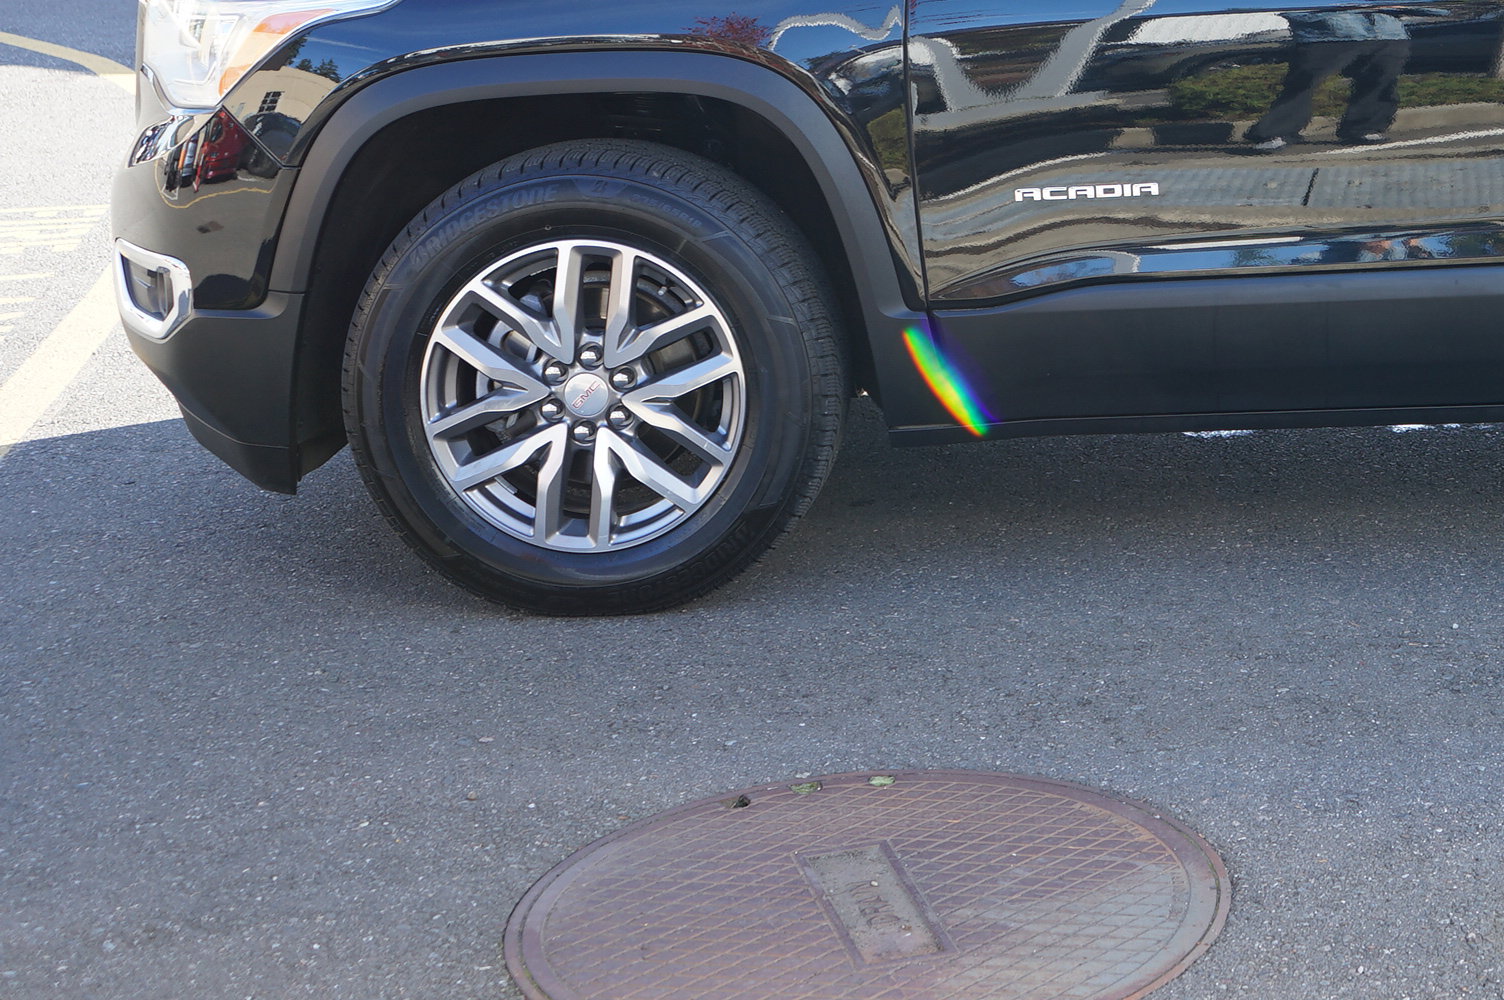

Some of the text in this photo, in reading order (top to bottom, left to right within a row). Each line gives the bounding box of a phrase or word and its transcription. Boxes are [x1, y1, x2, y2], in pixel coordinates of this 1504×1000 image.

[1014, 182, 1159, 201] ACADIA
[409, 184, 558, 267] BRIDGESTONE
[572, 380, 601, 409] GMC
